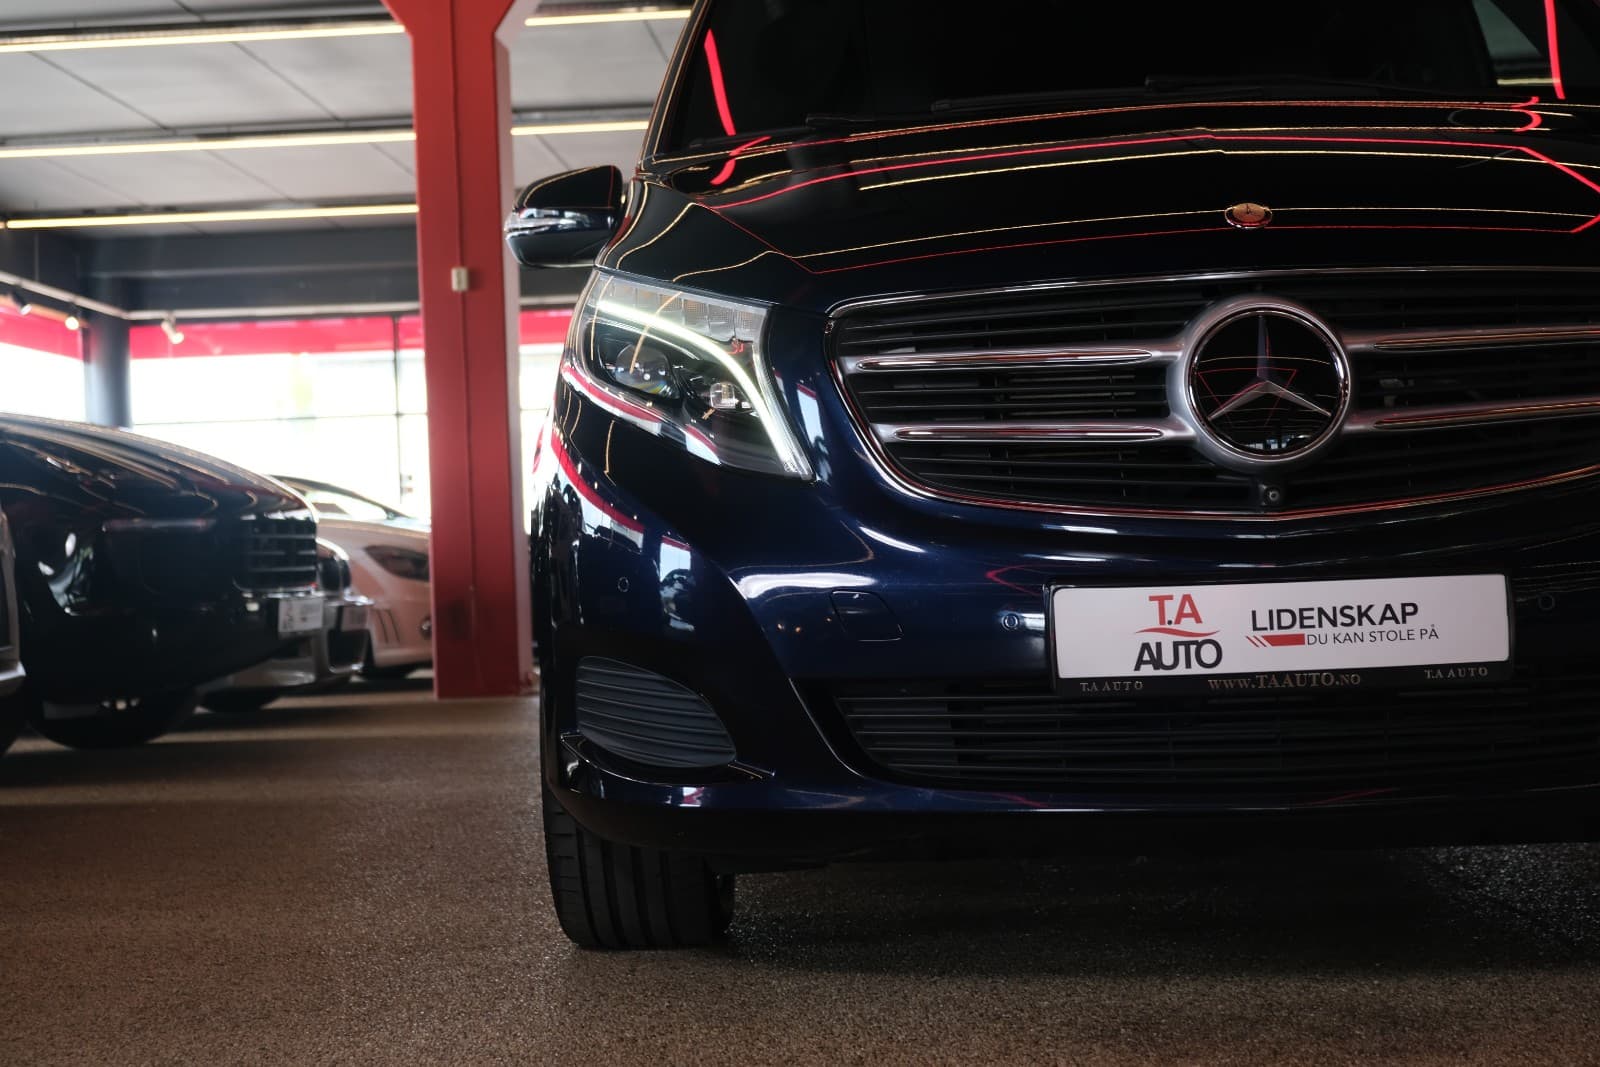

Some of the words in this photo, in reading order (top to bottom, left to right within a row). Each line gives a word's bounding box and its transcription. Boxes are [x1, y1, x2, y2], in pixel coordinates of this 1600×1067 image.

[1149, 594, 1202, 625] T.A
[1251, 603, 1418, 631] LIDENSKAP
[1307, 634, 1328, 645] DU
[1333, 632, 1364, 644] KAN
[1369, 630, 1415, 643] STOLE
[1420, 625, 1438, 641] PÅ
[1134, 639, 1222, 671] AUTO
[1447, 667, 1488, 678] AUTO
[1102, 681, 1143, 691] AUTO
